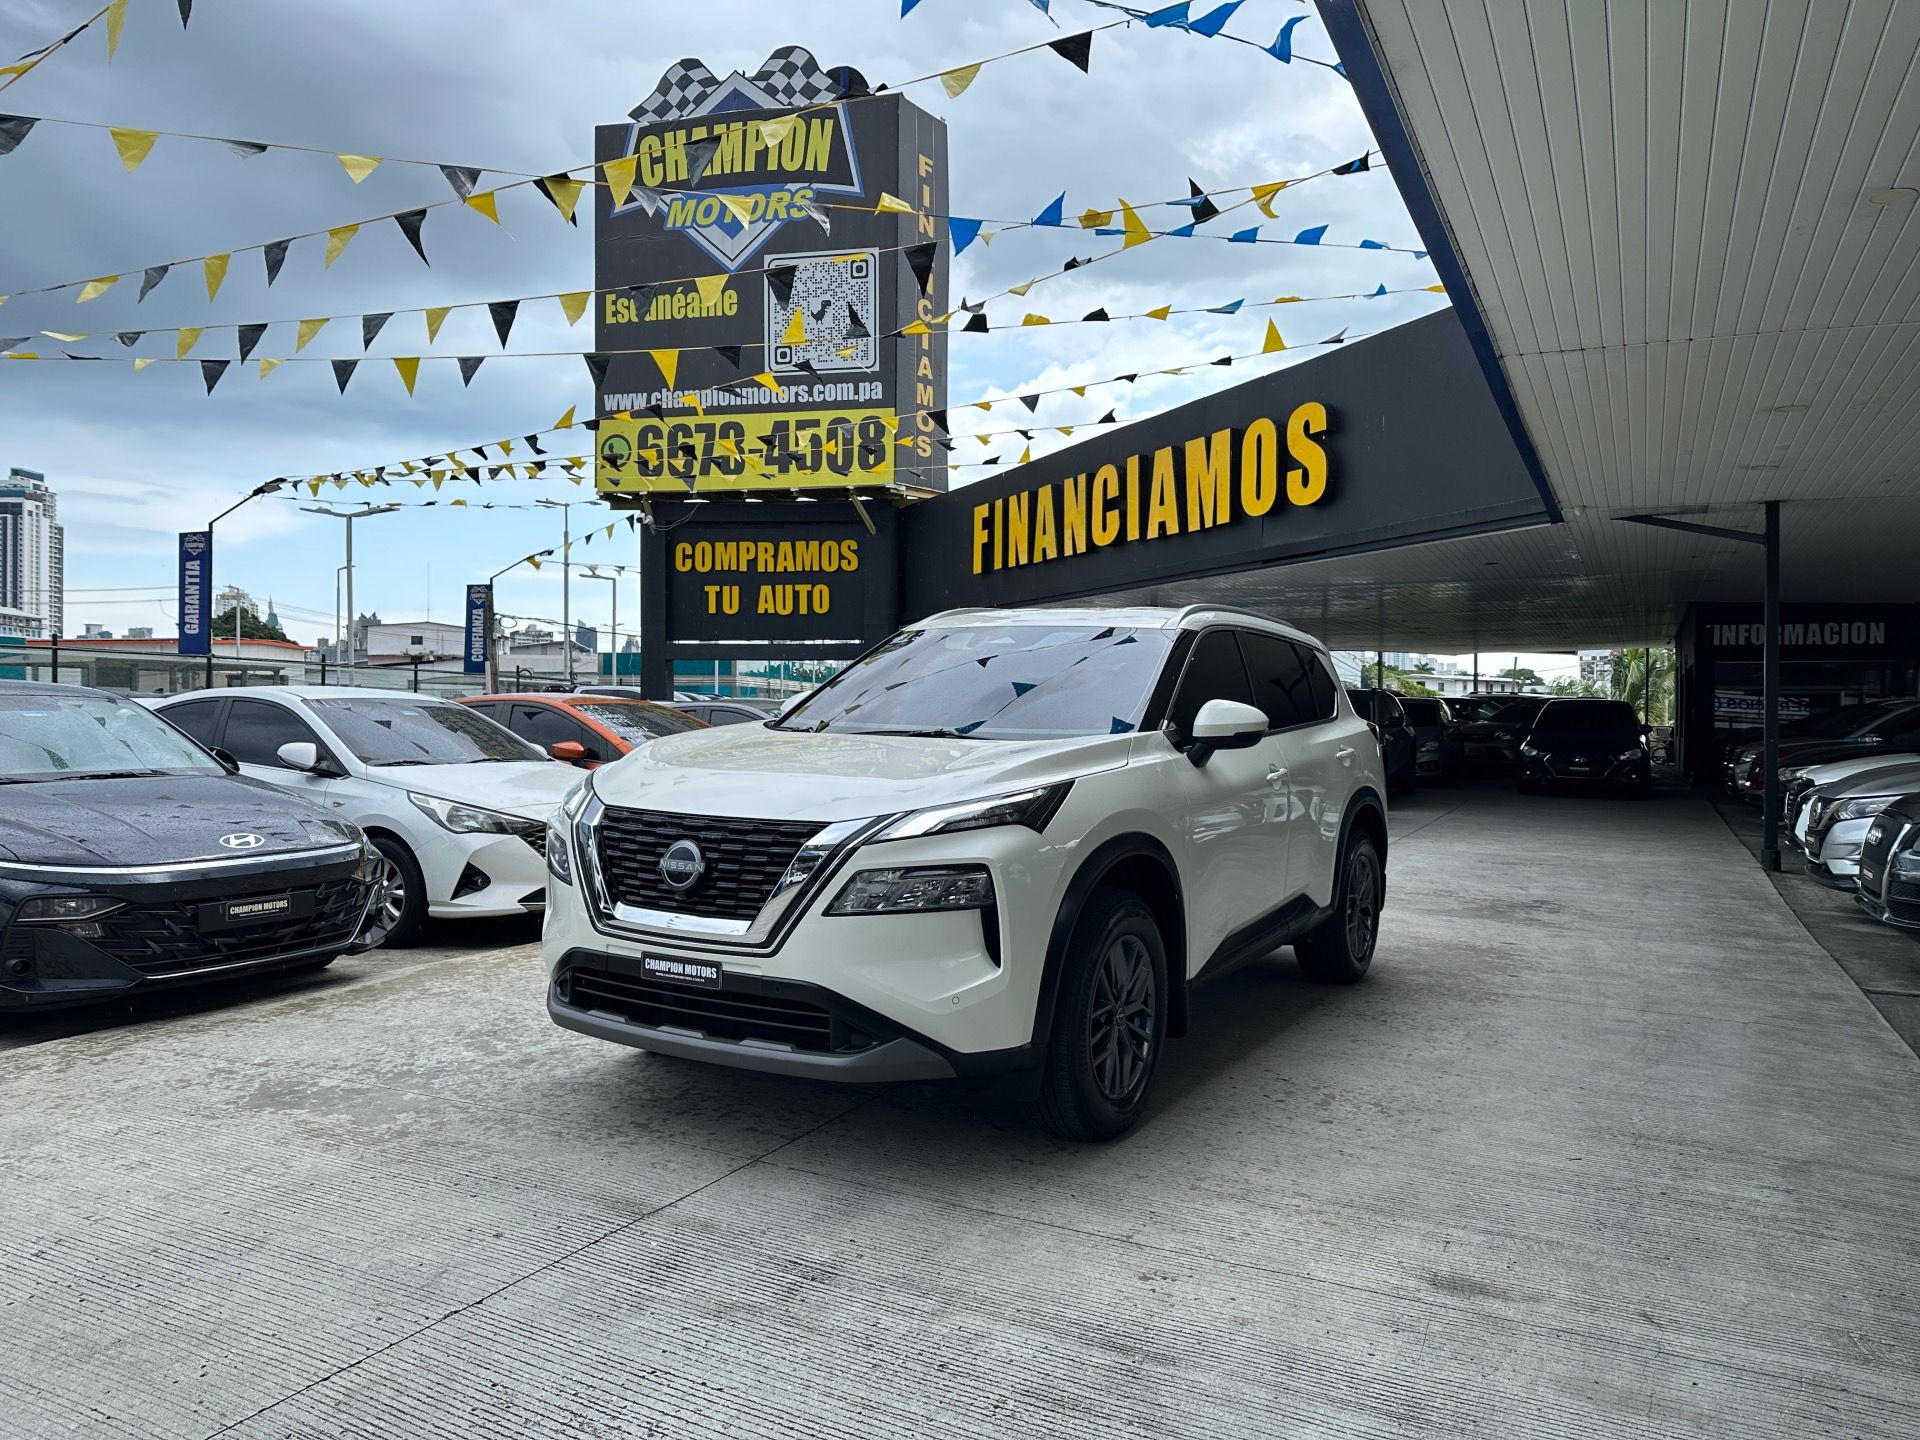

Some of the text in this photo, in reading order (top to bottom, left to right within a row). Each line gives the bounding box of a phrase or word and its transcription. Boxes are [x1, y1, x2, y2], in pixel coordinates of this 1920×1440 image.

[915, 154, 937, 458] FINCIAMOS
[637, 415, 886, 479] 6673-4508
[973, 402, 1327, 575] FINANCIAMOS
[675, 540, 859, 573] COMPRAMOS
[184, 560, 200, 635] GARANTIA
[704, 584, 830, 615] TU AUTO
[471, 608, 484, 662] CONFIANZA
[1713, 621, 1885, 646] INFOMACION
[660, 859, 704, 872] NISSAN
[229, 903, 263, 915] CHAMPION
[263, 899, 288, 910] MOTORS
[645, 958, 683, 974] CHAMPION
[684, 963, 717, 979] MOTORS
